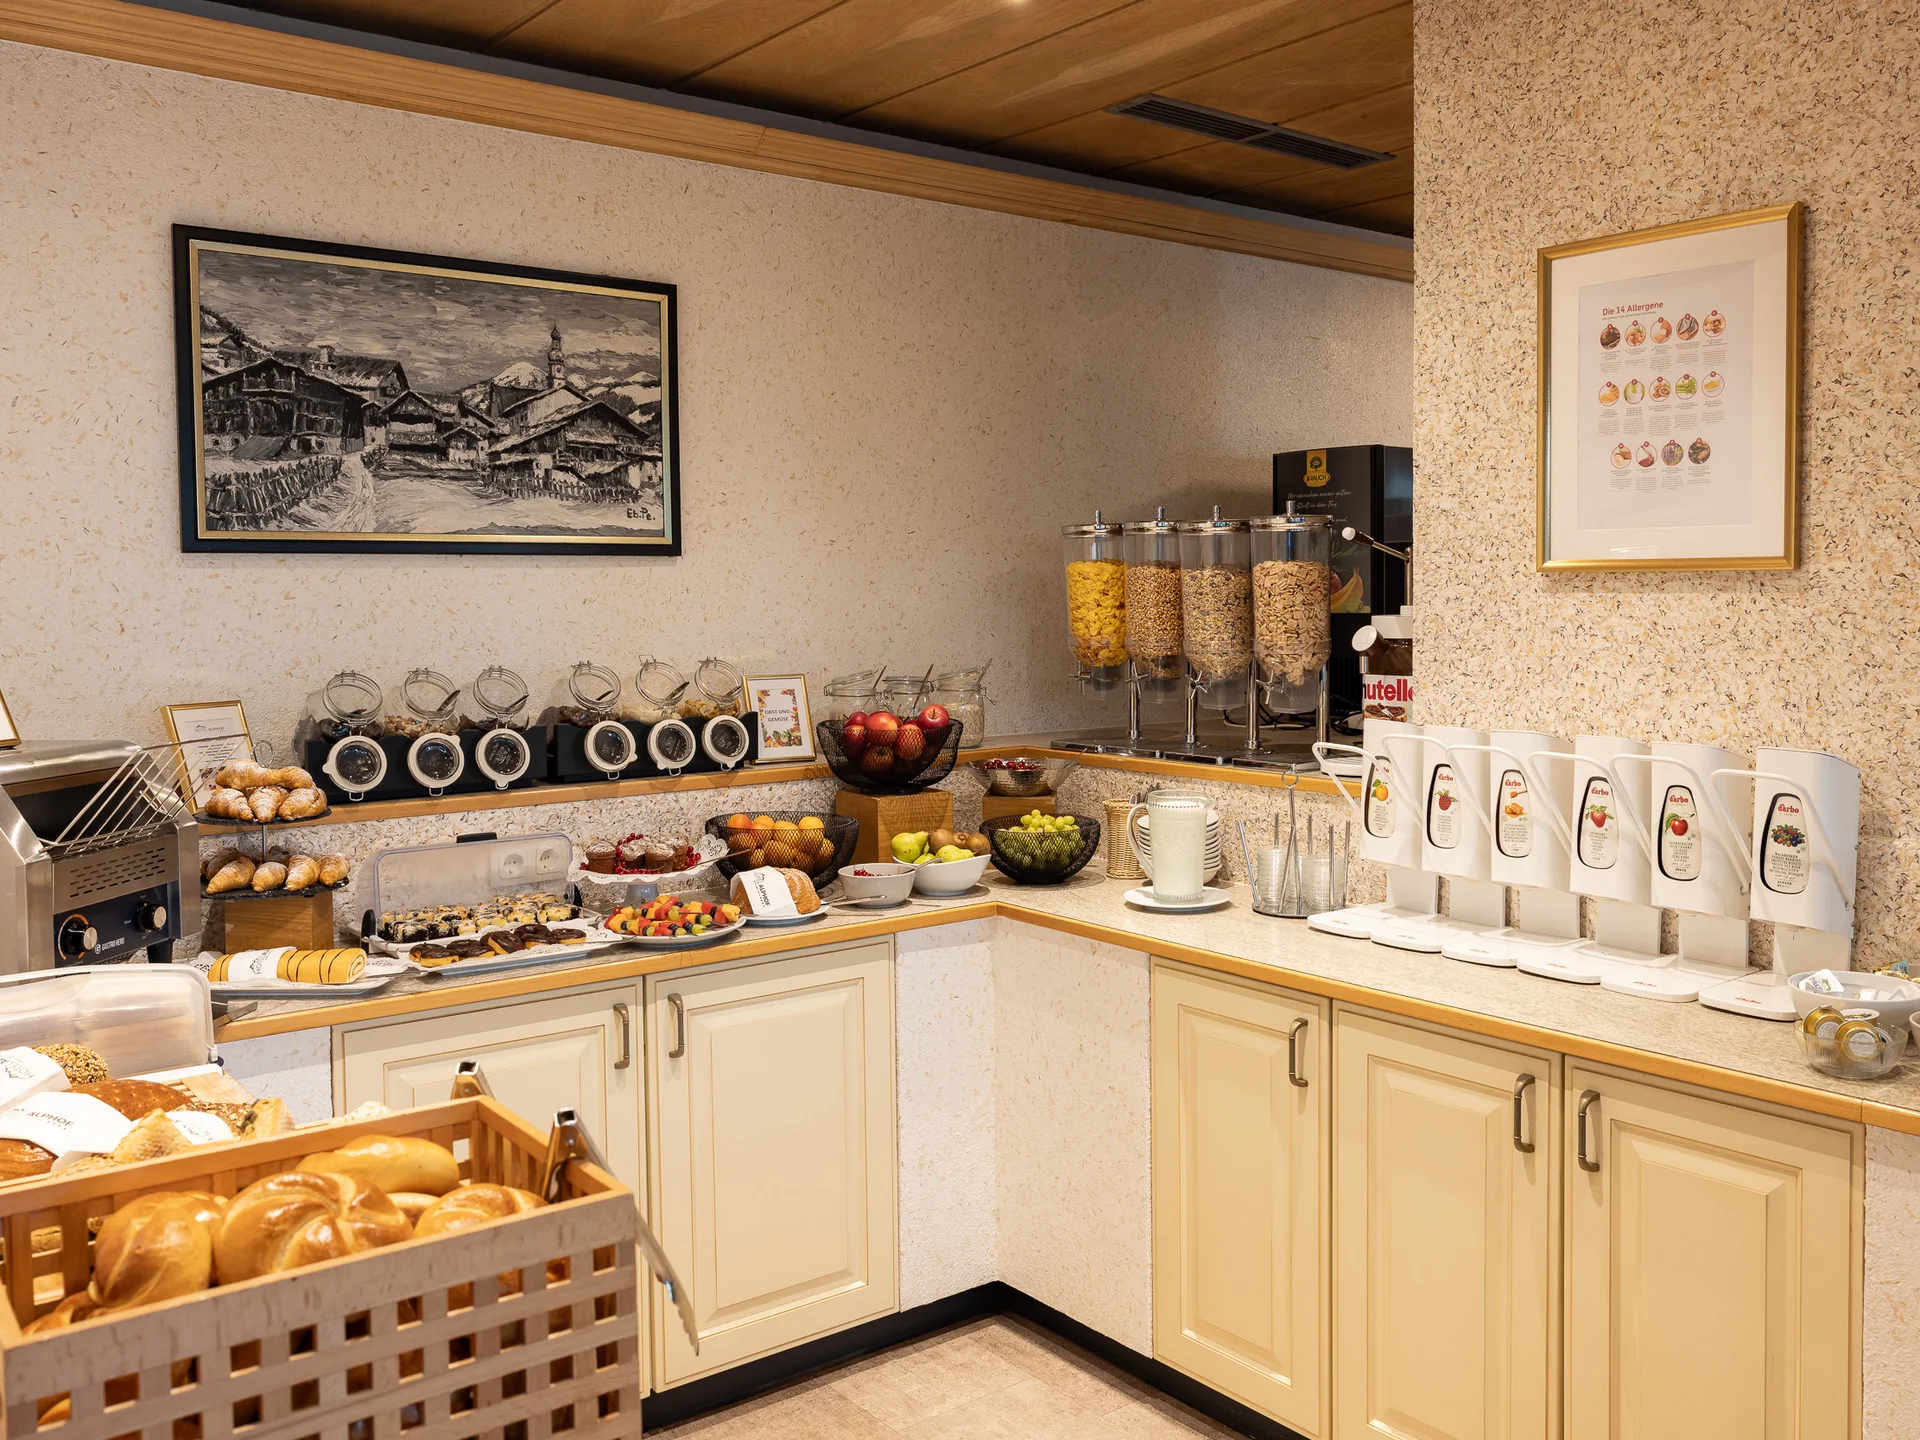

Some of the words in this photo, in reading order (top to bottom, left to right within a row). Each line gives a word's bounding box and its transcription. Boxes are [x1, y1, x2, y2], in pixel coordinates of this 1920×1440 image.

[1602, 308, 1615, 316] Die
[1616, 305, 1625, 314] 14
[1626, 302, 1664, 312] Allergene
[1362, 678, 1413, 702] nutell
[759, 884, 771, 906] ALPHOF
[102, 941, 115, 951] GASTRO
[116, 938, 125, 947] HERO
[27, 1110, 74, 1127] ALPHOF
